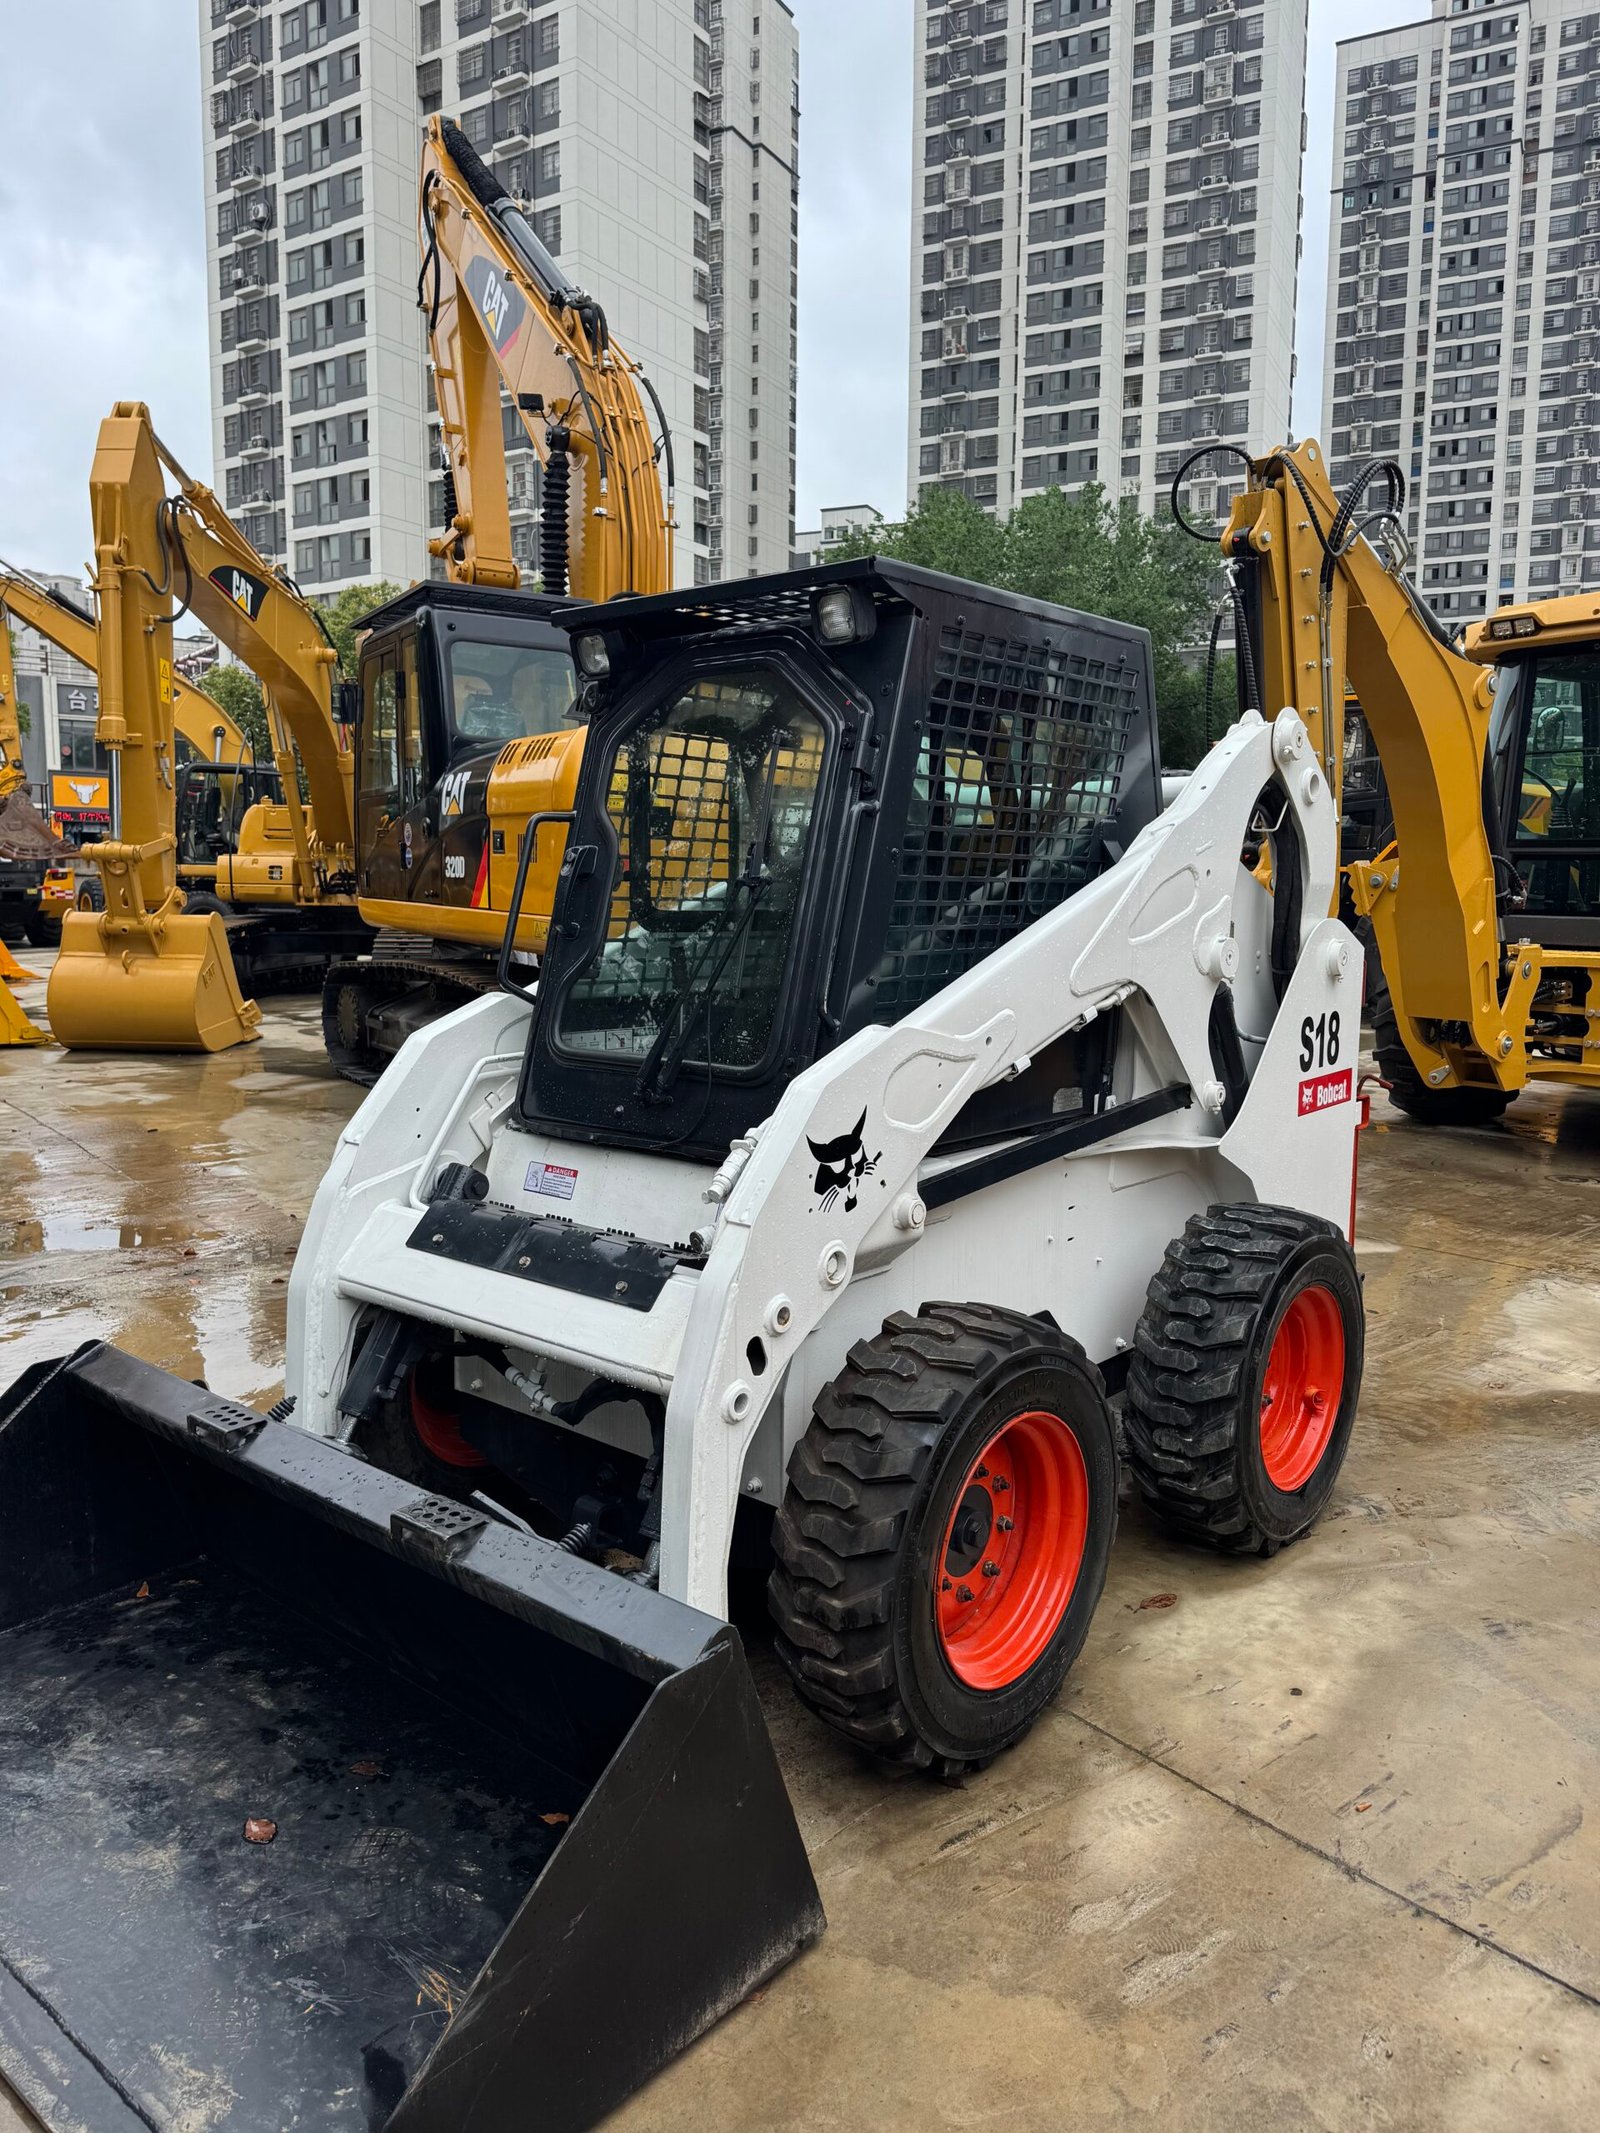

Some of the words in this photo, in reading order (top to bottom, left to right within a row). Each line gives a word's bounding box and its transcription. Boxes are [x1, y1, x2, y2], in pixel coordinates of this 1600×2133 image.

[482, 270, 510, 341] CAT
[232, 569, 254, 616] CAT
[441, 771, 472, 816] CAT
[445, 855, 465, 878] 320D
[1299, 1010, 1340, 1073] S18
[1316, 1078, 1348, 1107] Bobcat
[552, 1166, 575, 1177] DANGER
